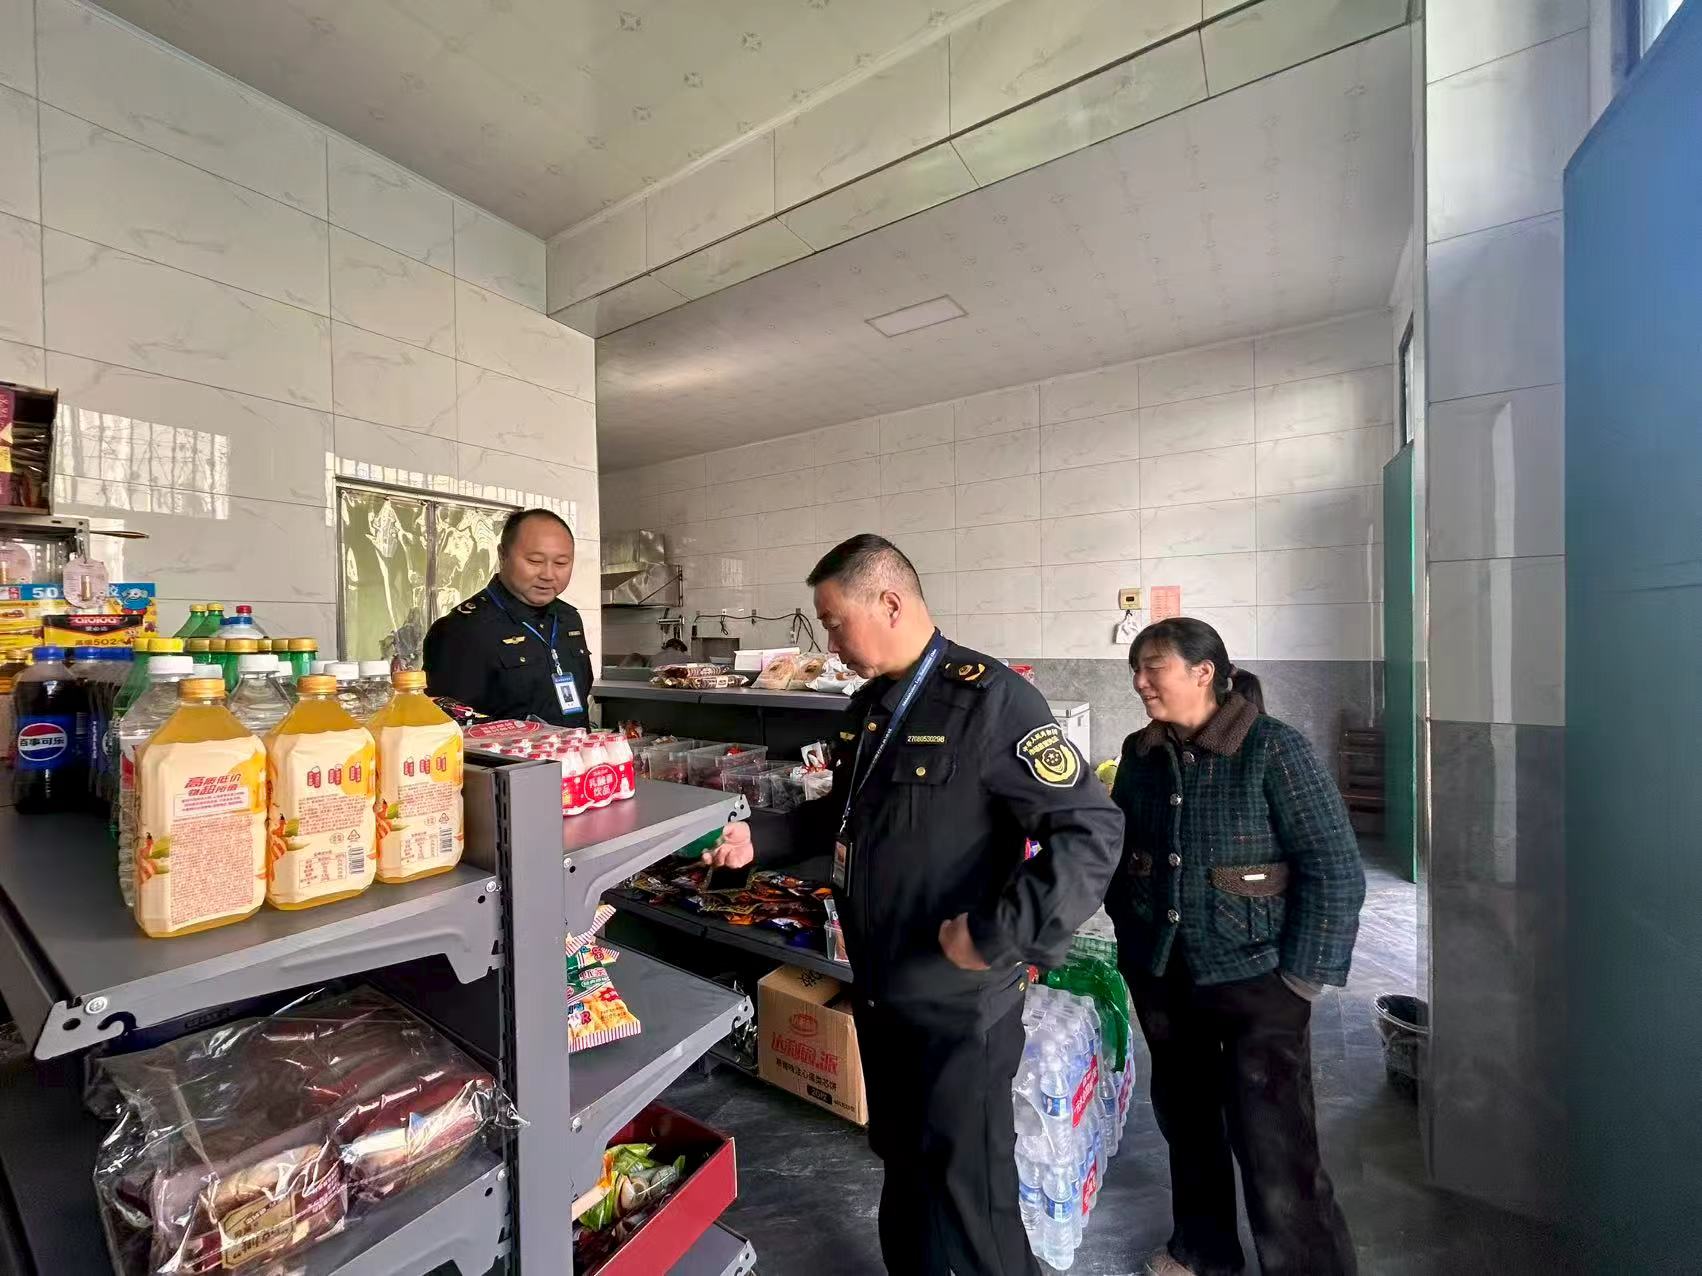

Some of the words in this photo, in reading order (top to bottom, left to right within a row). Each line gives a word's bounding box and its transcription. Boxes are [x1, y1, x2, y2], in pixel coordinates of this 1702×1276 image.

[20, 736, 65, 748] 百事可乐
[188, 783, 239, 797] 物超所值
